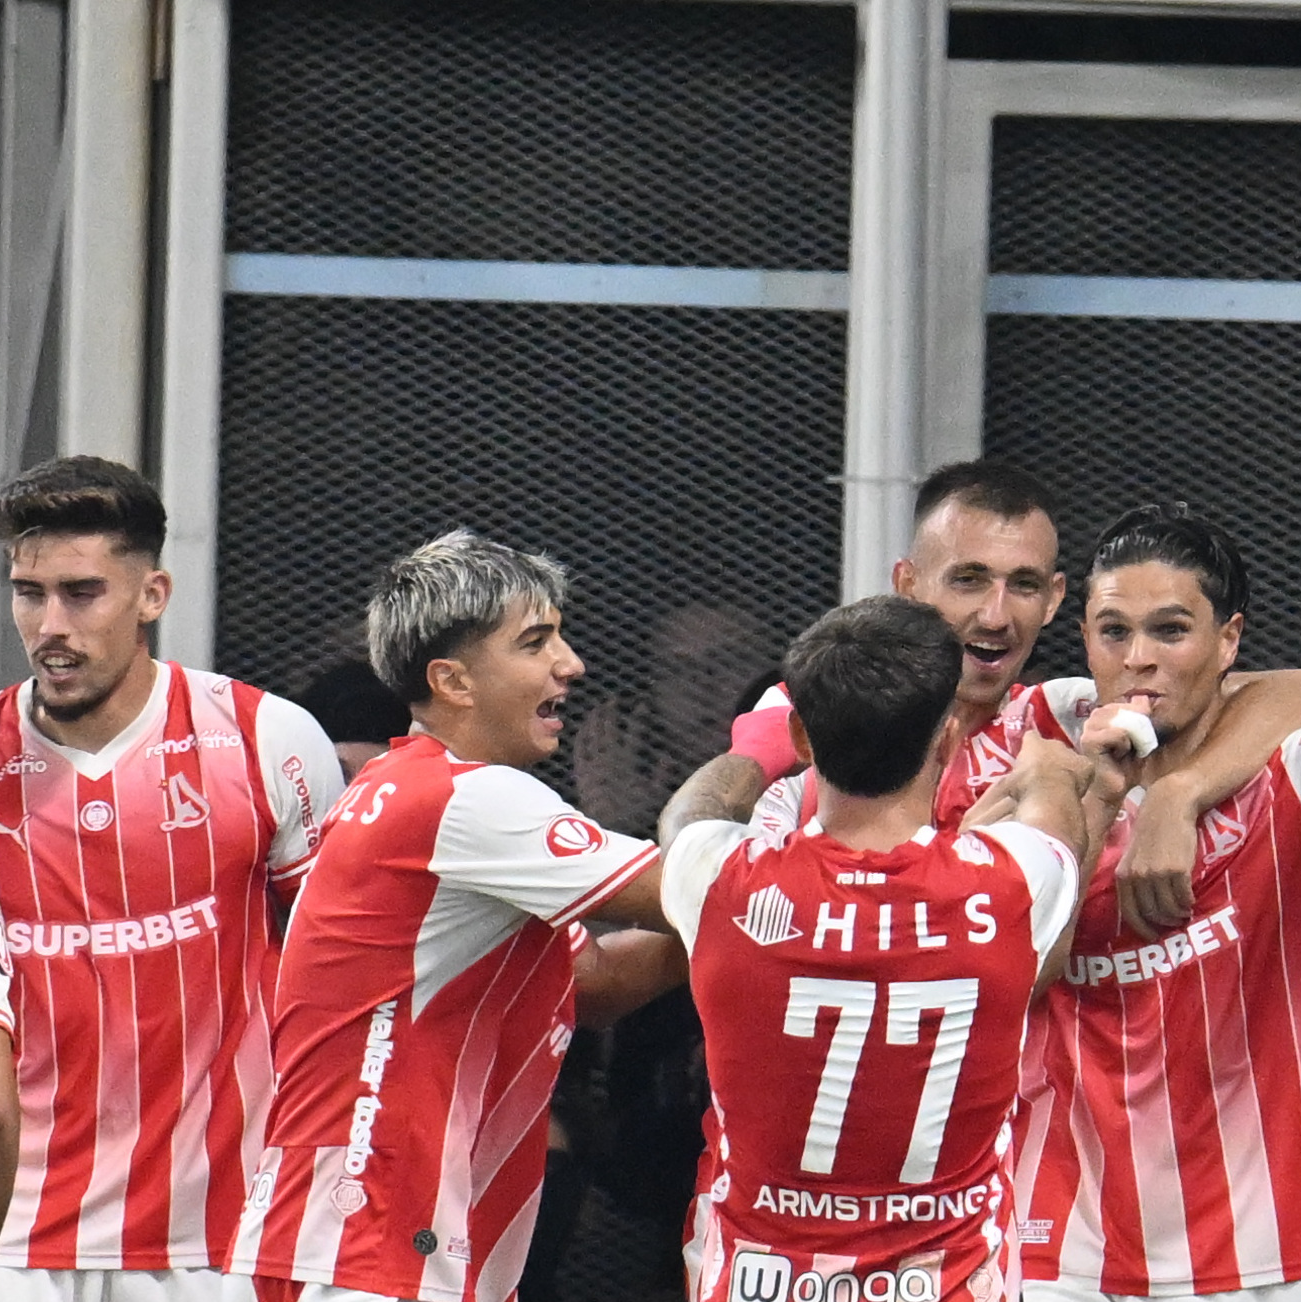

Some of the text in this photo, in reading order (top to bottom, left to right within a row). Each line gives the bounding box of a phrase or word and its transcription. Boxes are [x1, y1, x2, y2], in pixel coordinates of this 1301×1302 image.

[295, 776, 321, 849] romsta
[8, 896, 218, 957] SUPERBET
[811, 892, 998, 952] HILS
[1063, 904, 1240, 987] UPERBET
[783, 977, 979, 1184] 77
